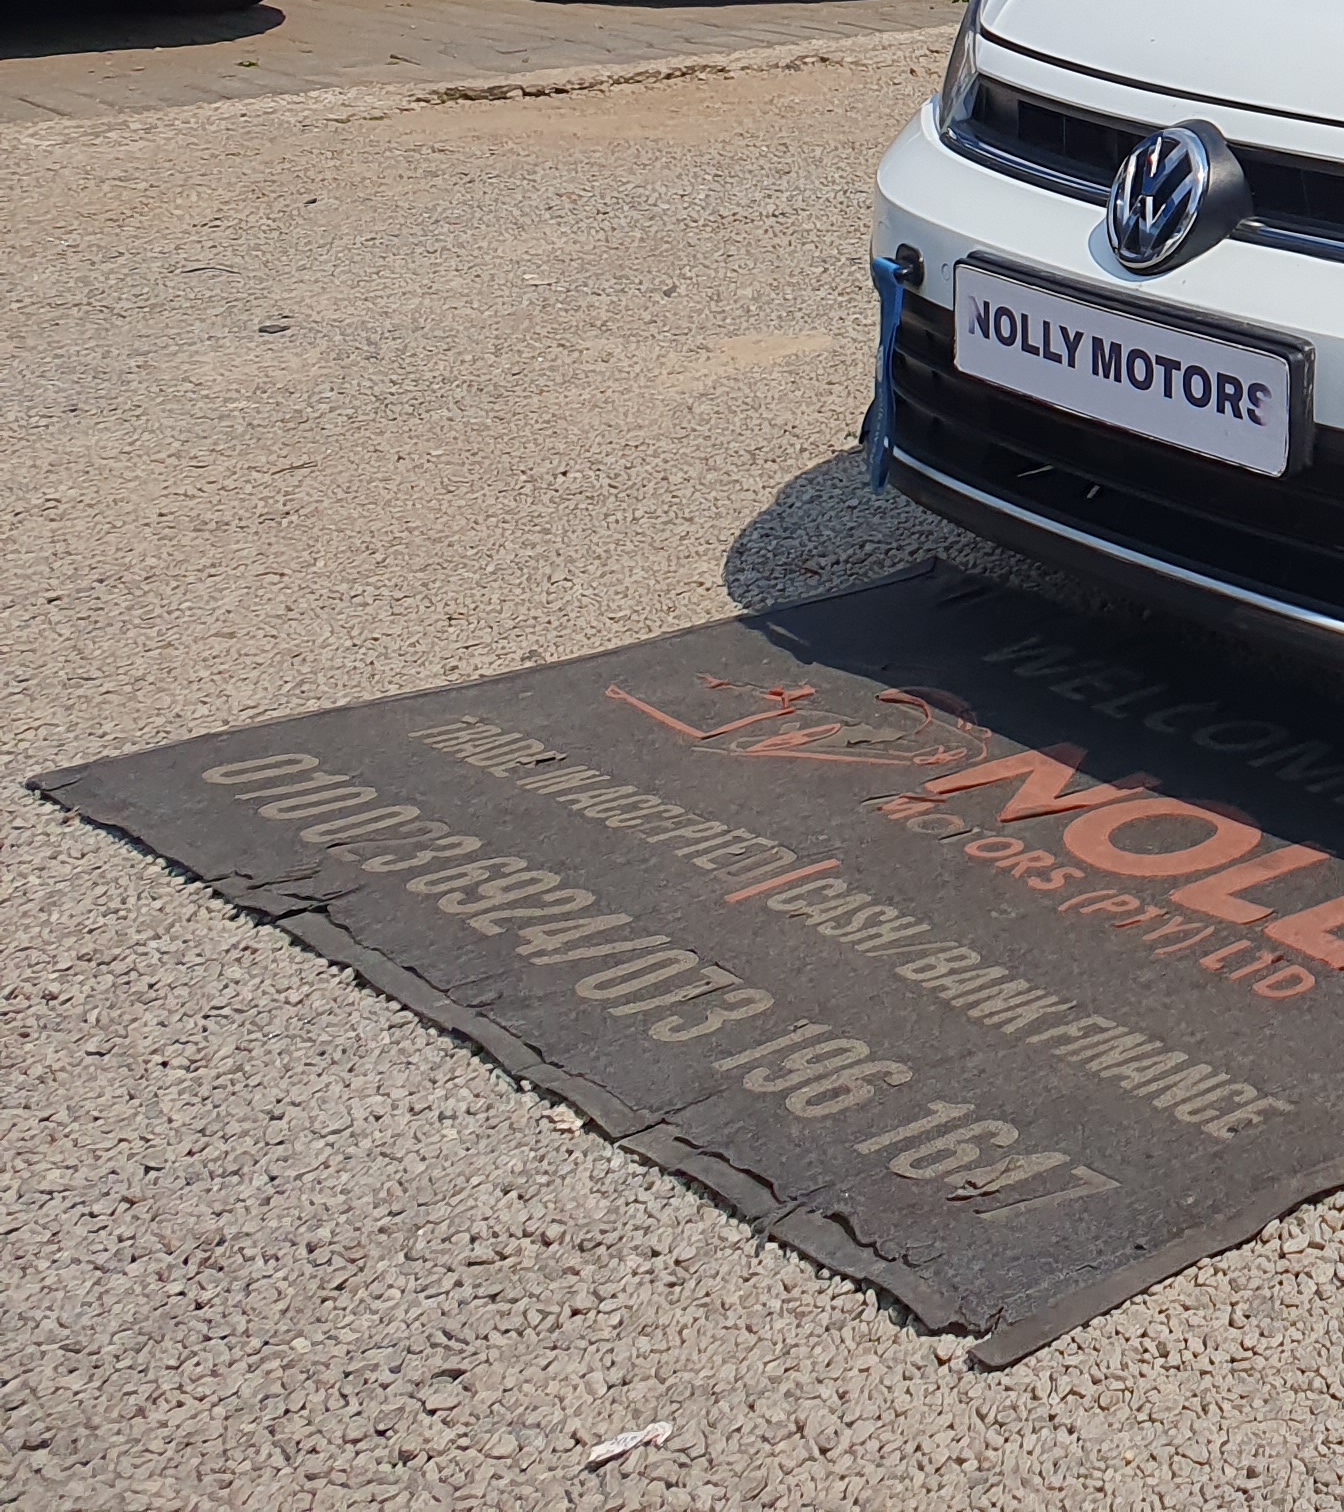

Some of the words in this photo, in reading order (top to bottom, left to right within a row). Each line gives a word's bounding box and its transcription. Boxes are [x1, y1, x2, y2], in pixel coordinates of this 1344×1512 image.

[968, 296, 1084, 369] NOLLY
[1091, 335, 1274, 427] MOTORS
[201, 753, 378, 821] 010
[299, 804, 483, 873] 023
[406, 856, 775, 1043] 6924/073
[711, 1018, 913, 1118] 196
[852, 1099, 1123, 1221] 1647
[407, 715, 567, 778] TRADE
[515, 764, 611, 795] IN
[766, 879, 1077, 1034] CASH/BANK
[1025, 1014, 1297, 1140] FINANCE
[862, 792, 1085, 890] MOTORS
[1057, 889, 1215, 955] (PTY)
[1200, 939, 1317, 1000] LTD
